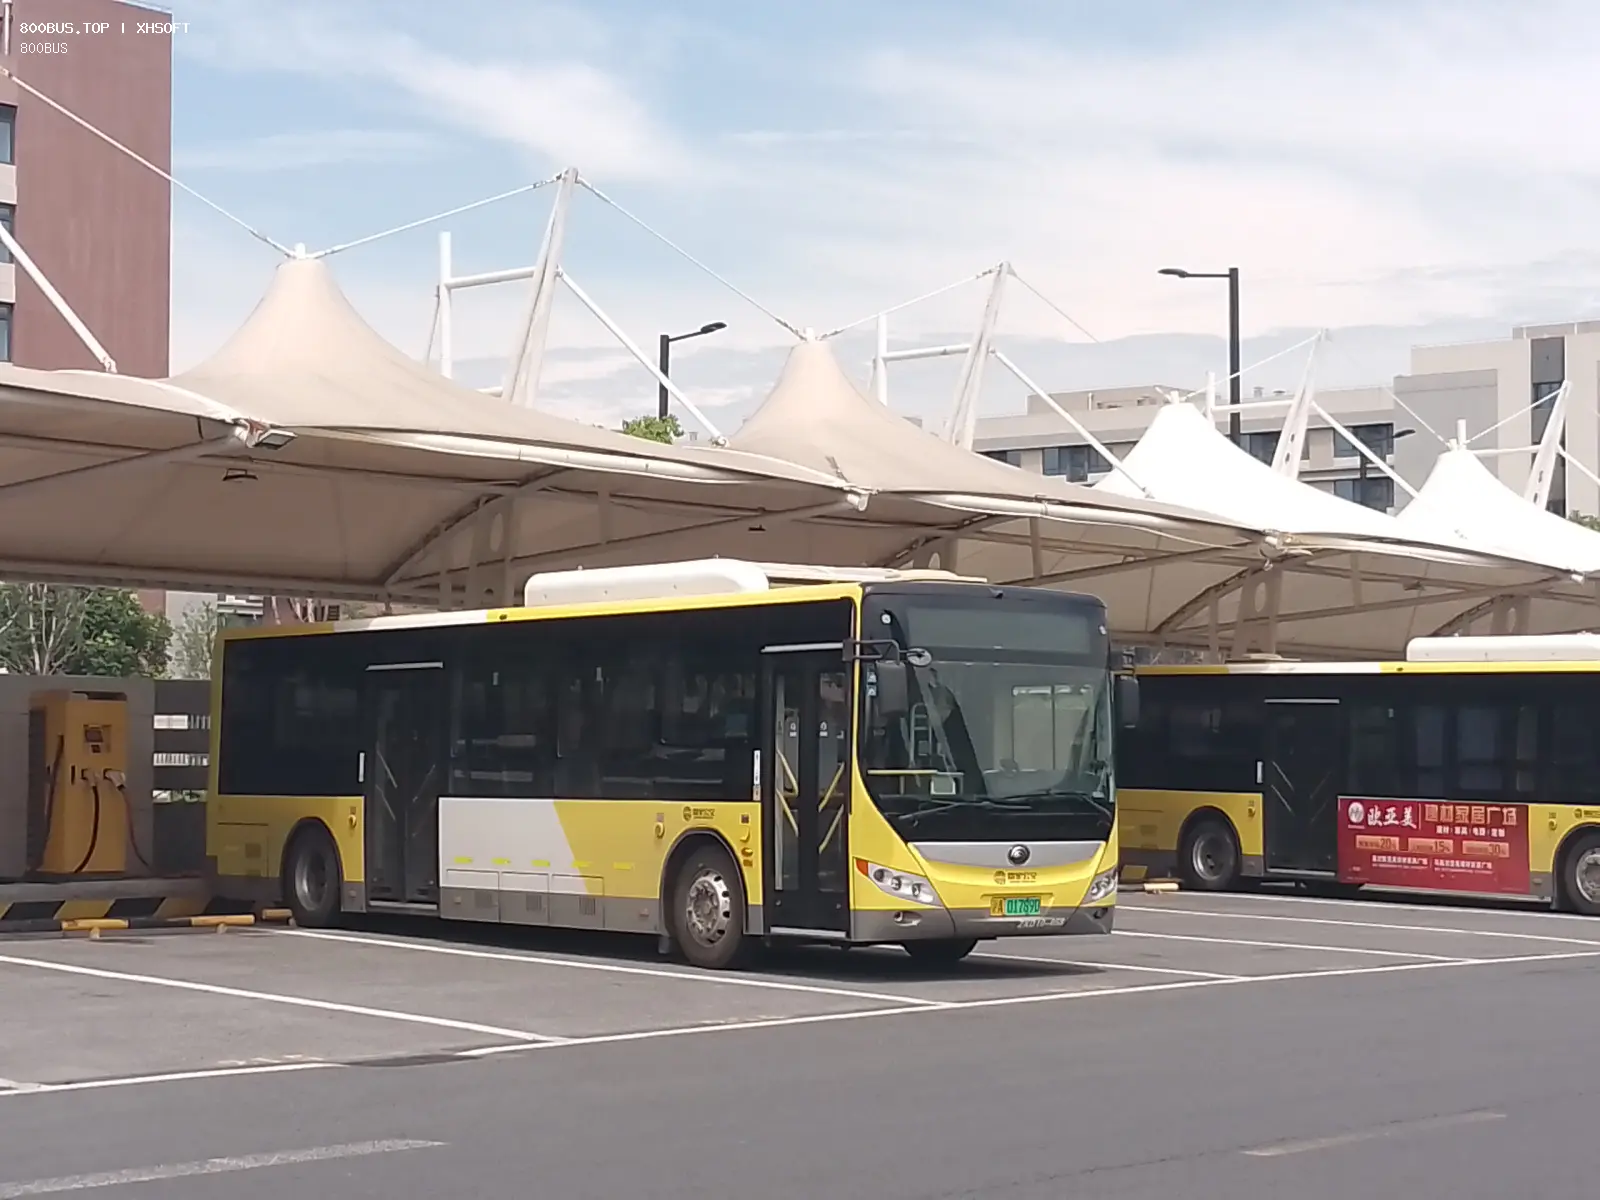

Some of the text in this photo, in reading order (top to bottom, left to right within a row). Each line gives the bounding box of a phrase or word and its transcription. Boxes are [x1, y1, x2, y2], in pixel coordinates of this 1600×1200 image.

[1367, 804, 1417, 829] 欧亚美
[1424, 804, 1517, 826] 建材家居广场
